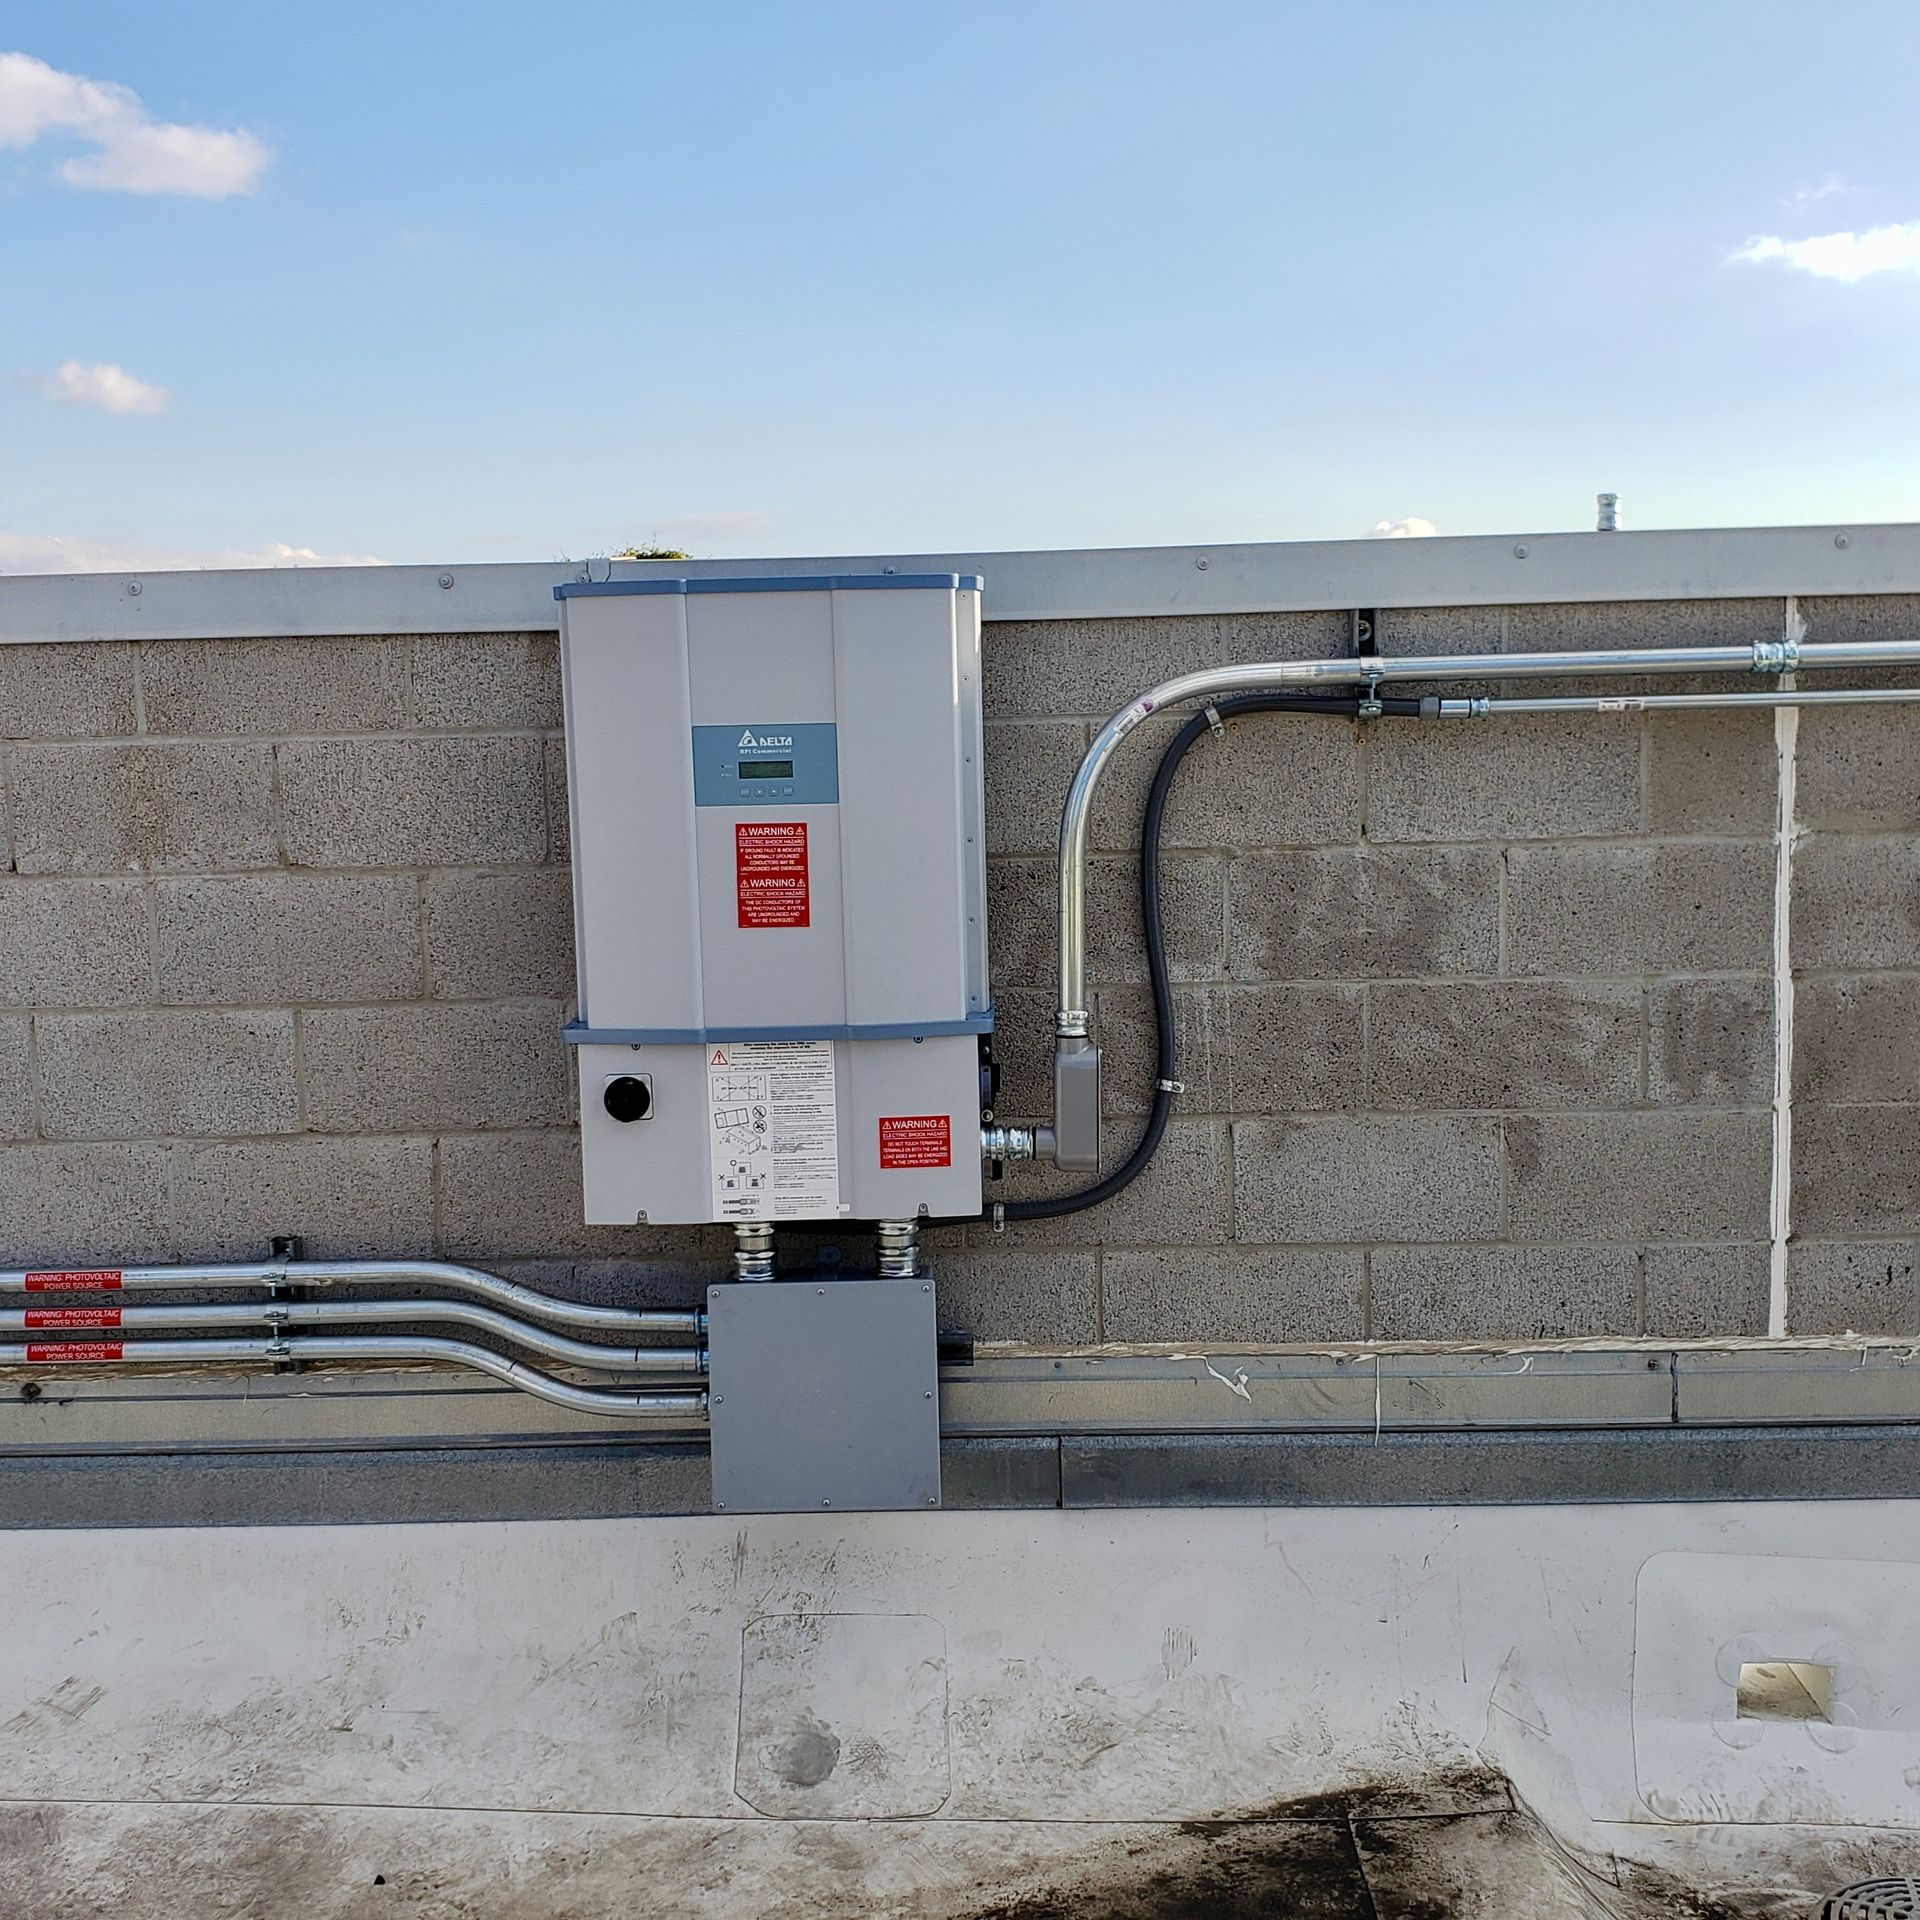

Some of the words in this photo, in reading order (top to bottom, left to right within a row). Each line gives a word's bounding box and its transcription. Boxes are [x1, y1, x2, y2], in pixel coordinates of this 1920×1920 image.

[760, 737, 792, 746] DELTA
[748, 827, 794, 836] WARNING
[750, 879, 795, 887] WARNING
[892, 1120, 937, 1129] WARNING
[27, 1274, 64, 1282] WARNING:
[68, 1343, 122, 1351] PHOTOVOLTAIC
